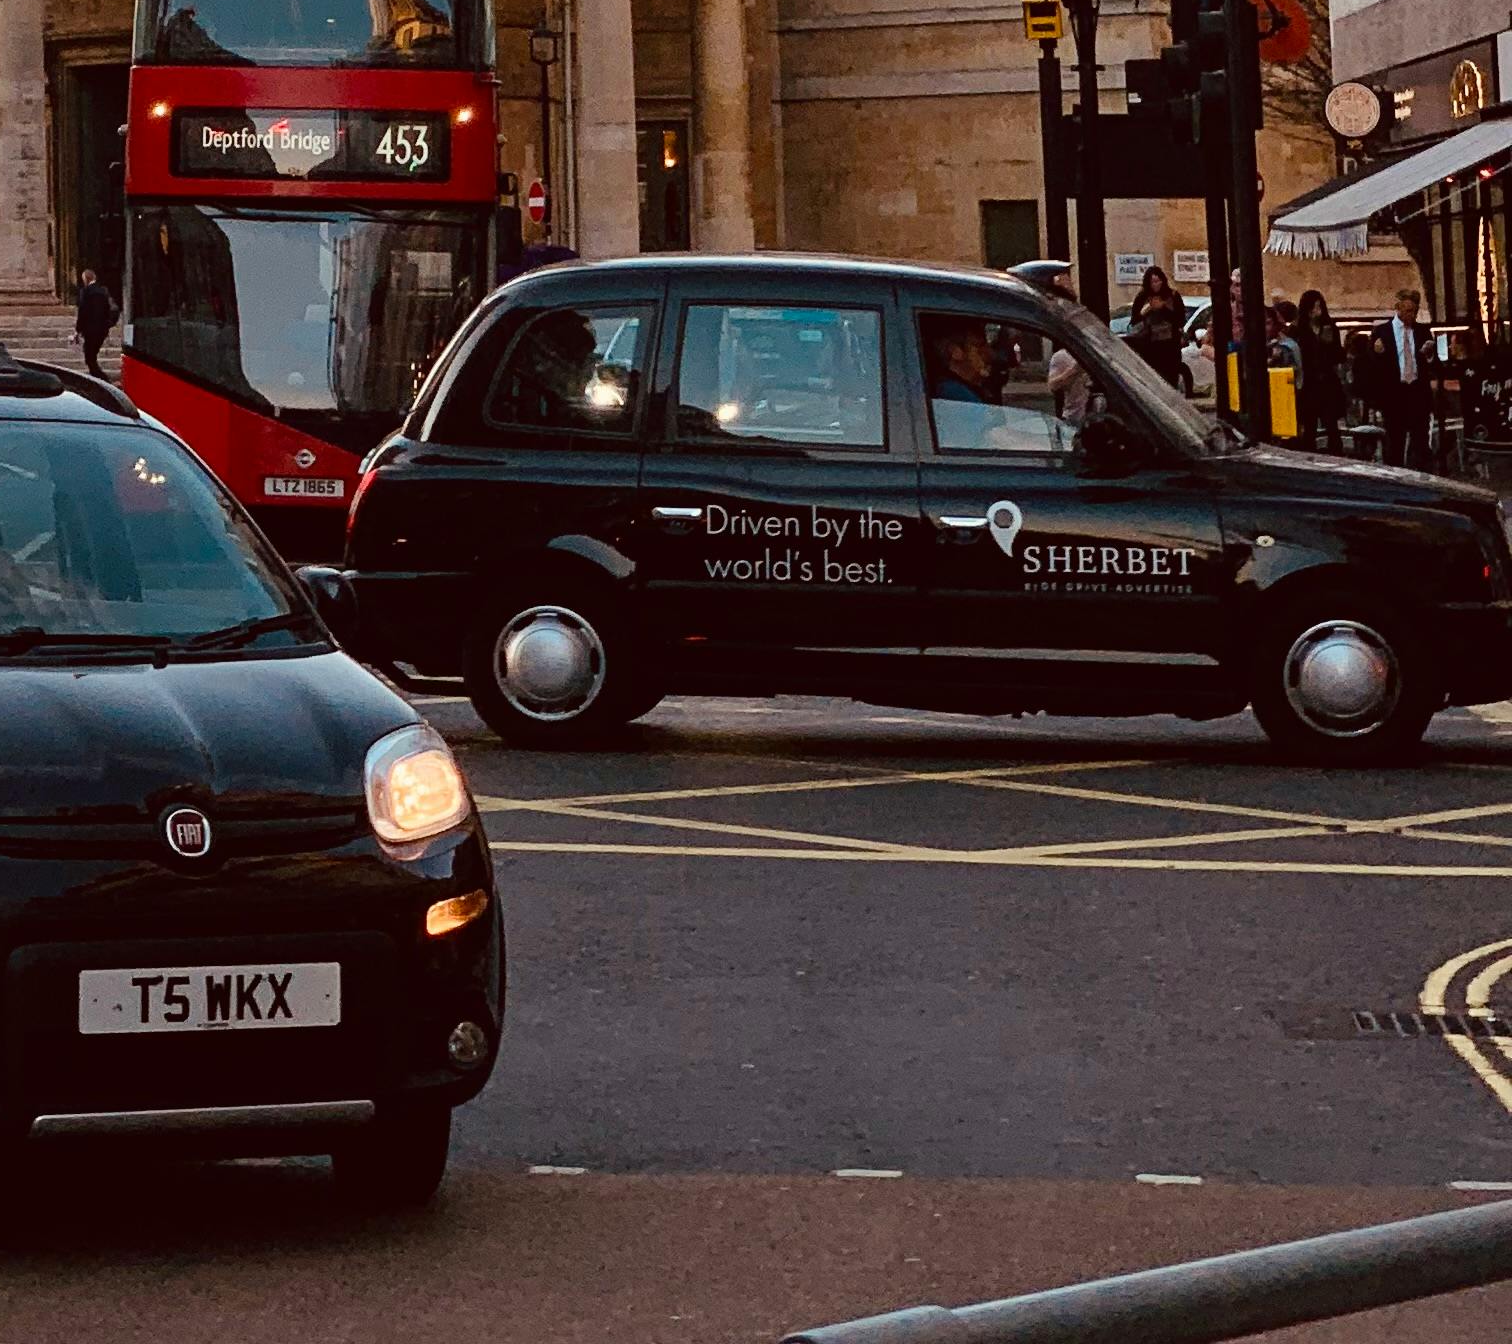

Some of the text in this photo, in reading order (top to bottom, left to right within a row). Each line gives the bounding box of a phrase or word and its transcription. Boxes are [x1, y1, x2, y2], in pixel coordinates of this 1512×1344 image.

[202, 125, 331, 156] Deptford Bridge
[375, 124, 430, 165] 453
[272, 479, 336, 494] LTZ 1865
[706, 504, 903, 547] Driven by the
[704, 548, 893, 584] world's best.
[1023, 545, 1196, 576] SHERBET
[176, 823, 202, 846] FIAT
[131, 972, 294, 1023] T5 WKX
